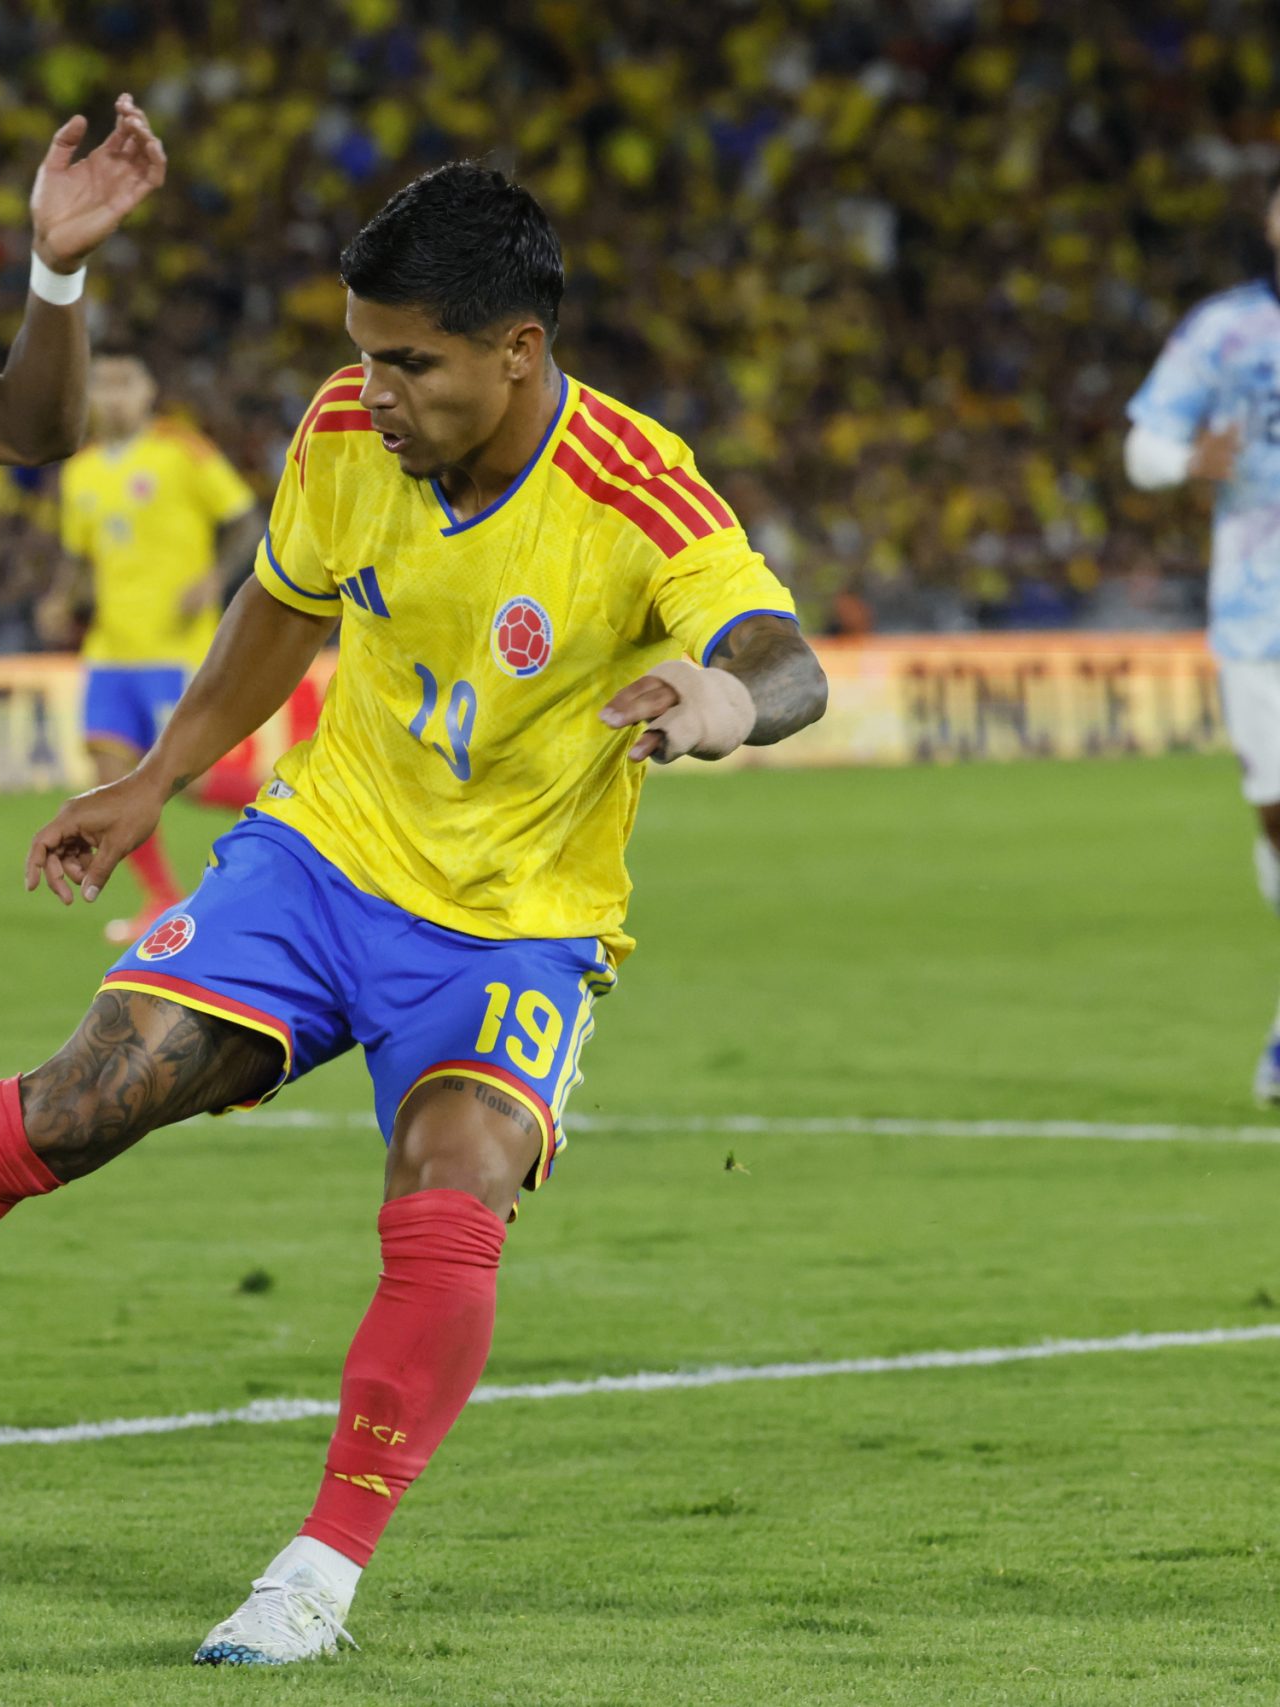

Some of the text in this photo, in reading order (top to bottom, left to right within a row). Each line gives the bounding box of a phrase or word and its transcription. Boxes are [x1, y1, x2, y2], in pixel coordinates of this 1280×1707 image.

[408, 662, 477, 781] 19
[475, 982, 563, 1079] 19
[353, 1414, 406, 1446] FCF
